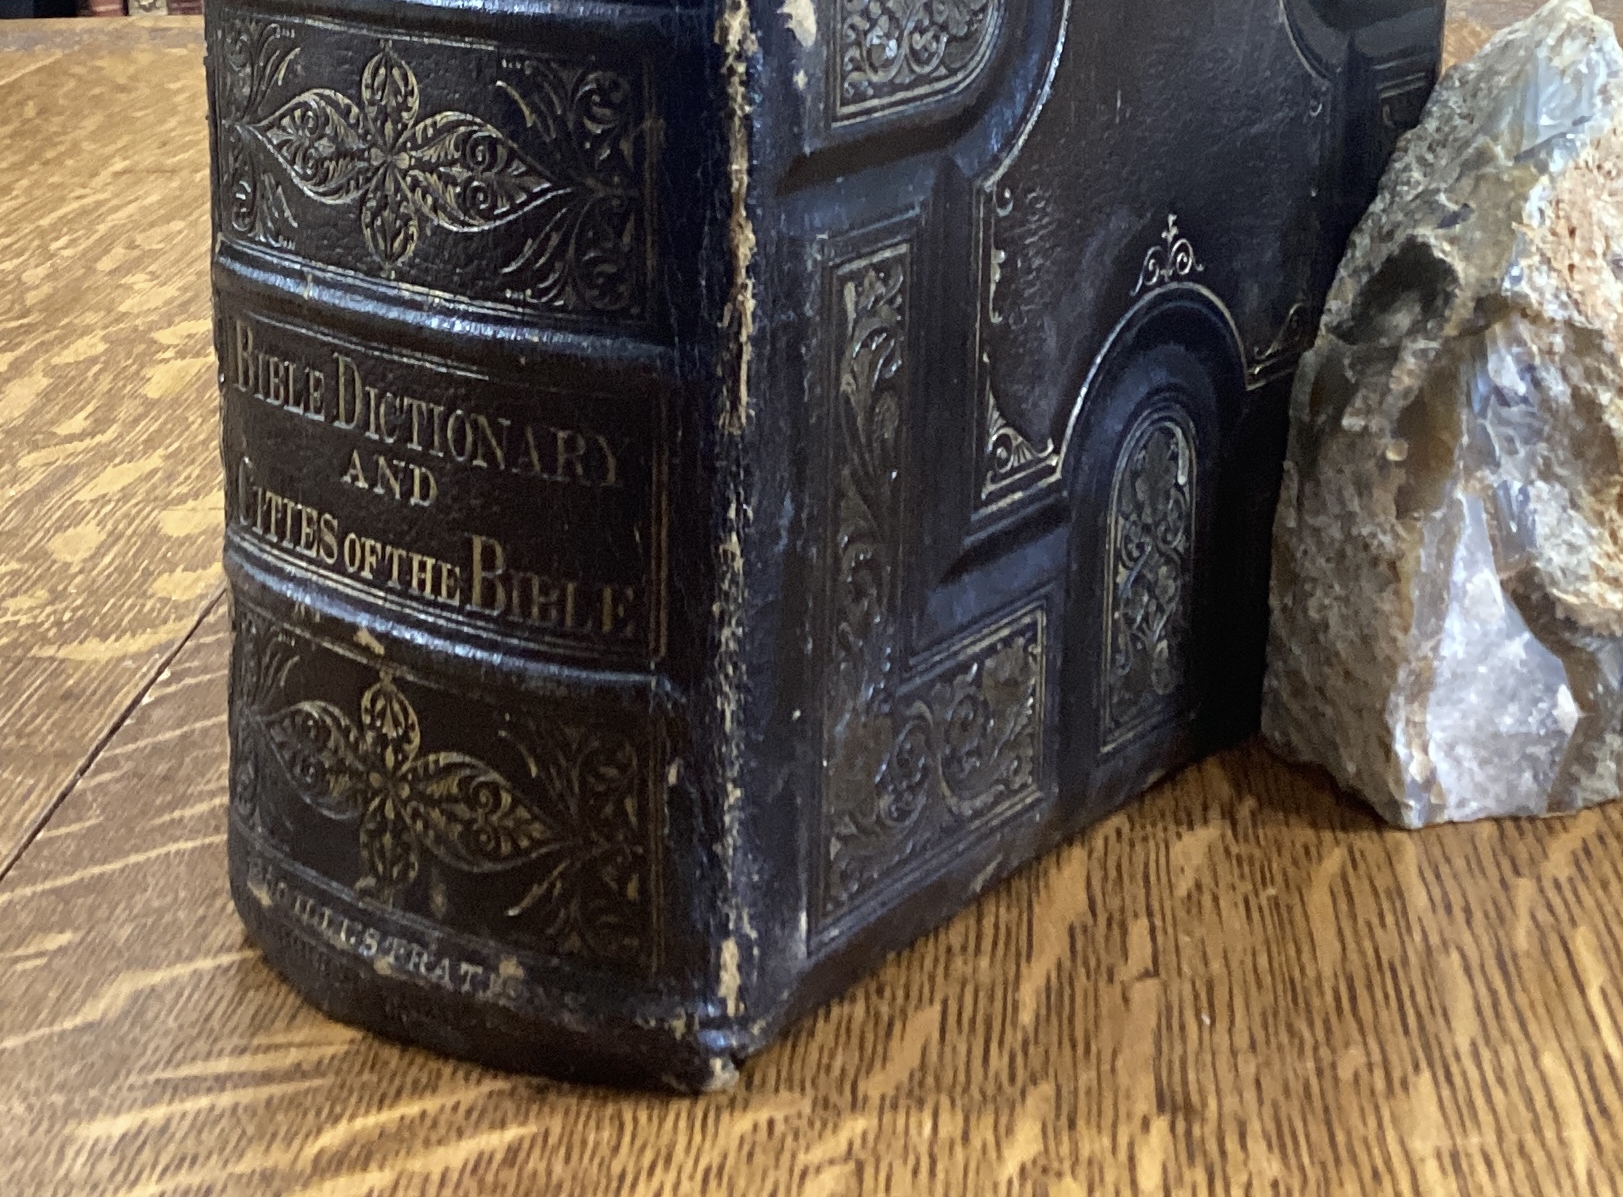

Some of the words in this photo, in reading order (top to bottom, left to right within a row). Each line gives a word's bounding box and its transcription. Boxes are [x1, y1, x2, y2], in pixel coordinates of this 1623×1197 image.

[234, 318, 325, 423] BIBLE
[333, 351, 626, 488] DICTIONARY
[340, 448, 439, 507] AND
[238, 455, 338, 565] CITIES
[344, 532, 384, 580] OF
[382, 546, 461, 607] THE
[464, 531, 636, 639] BIBLE
